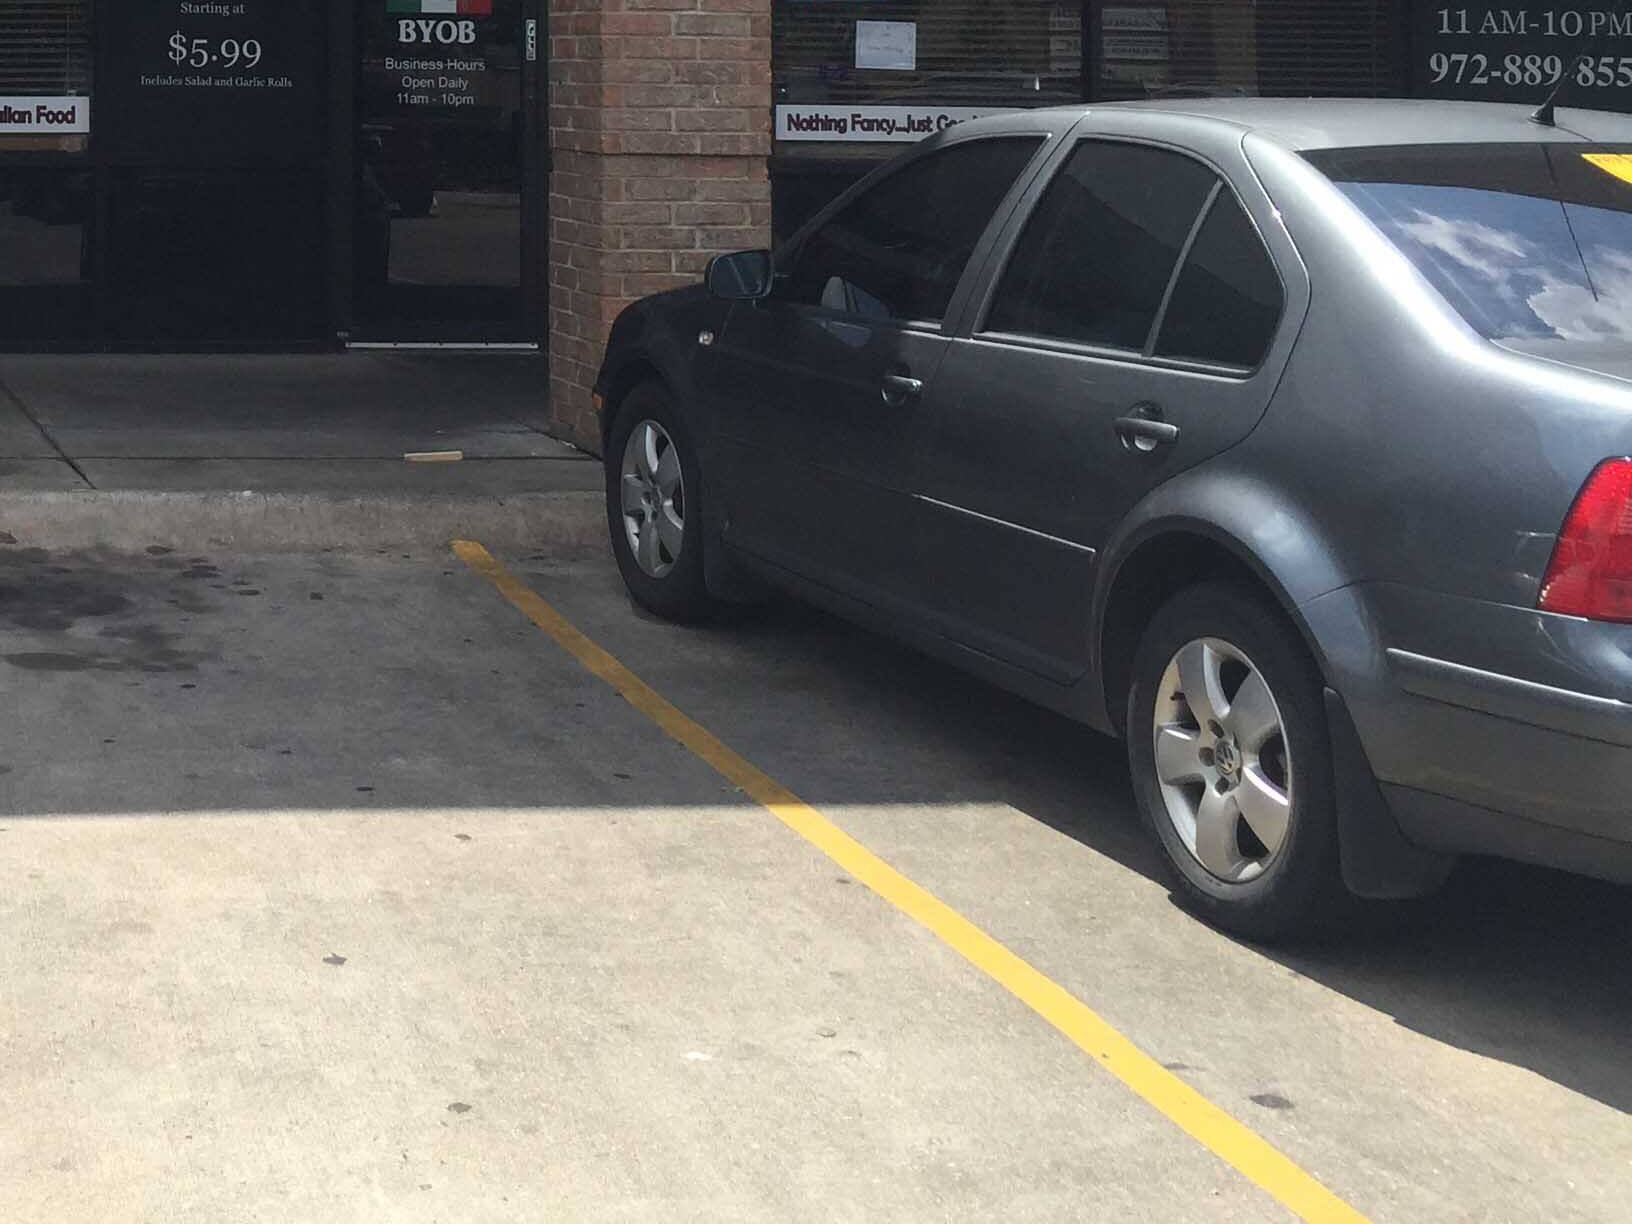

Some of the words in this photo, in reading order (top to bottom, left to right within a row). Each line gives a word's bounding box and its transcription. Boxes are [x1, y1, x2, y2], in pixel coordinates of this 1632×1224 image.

[180, 2, 230, 17] Starting
[233, 3, 246, 14] at
[1438, 9, 1471, 34] 11
[1589, 11, 1632, 36] PM
[398, 19, 476, 44] BYOB
[167, 30, 262, 68] $5.99
[385, 57, 443, 70] Business
[448, 58, 486, 71] Hours
[140, 75, 182, 86] Includes
[185, 76, 212, 86] Salad
[215, 77, 233, 86] and
[235, 77, 265, 87] Garlic
[268, 78, 293, 88] Rolls
[402, 76, 435, 89] Open
[439, 77, 469, 89] Daily
[396, 93, 429, 104] 11am
[443, 93, 474, 107] 10pm
[35, 105, 76, 124] Food
[786, 113, 848, 134] Nothing
